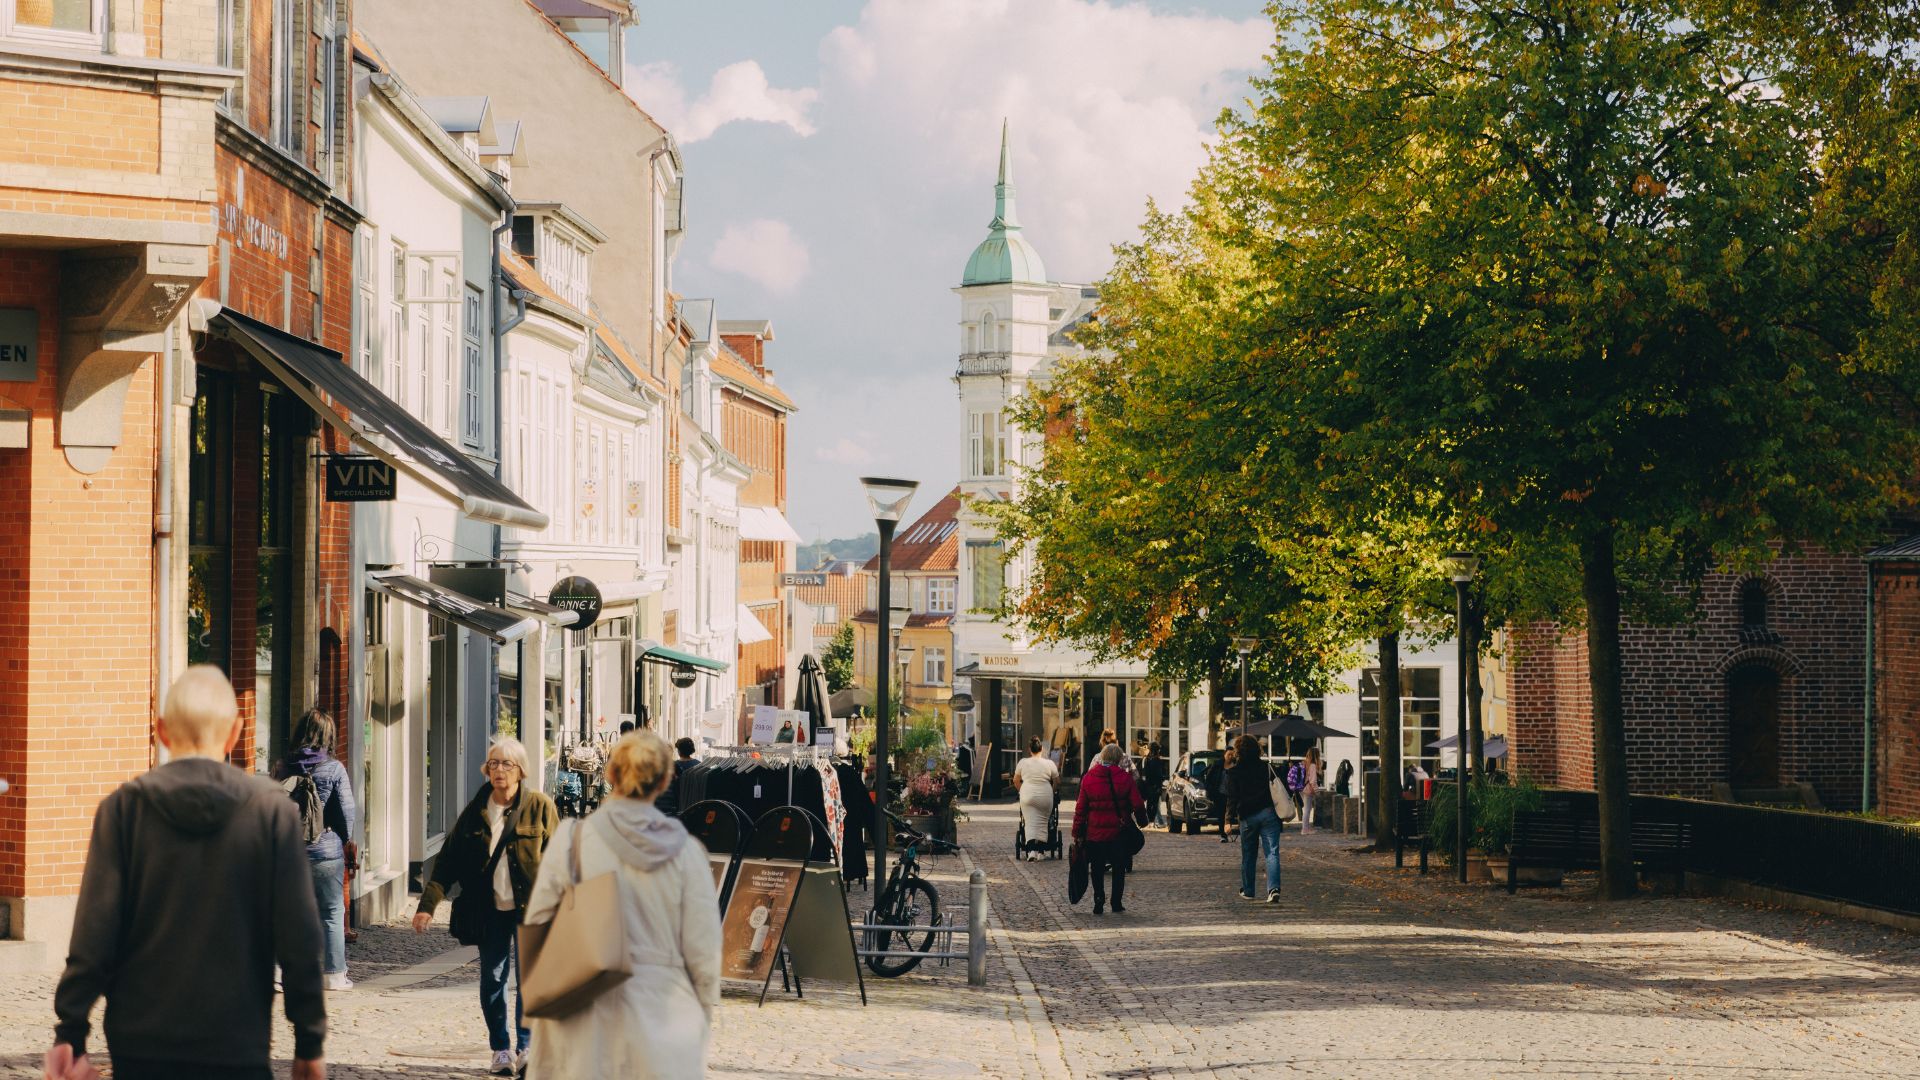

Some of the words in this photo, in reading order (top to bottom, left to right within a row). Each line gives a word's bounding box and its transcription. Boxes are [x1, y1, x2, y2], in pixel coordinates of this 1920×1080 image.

[335, 465, 390, 486] VIN
[334, 489, 390, 497] SPECIALISTEN
[785, 575, 822, 585] Bank
[588, 600, 597, 610] K
[984, 655, 1019, 666] MADISON
